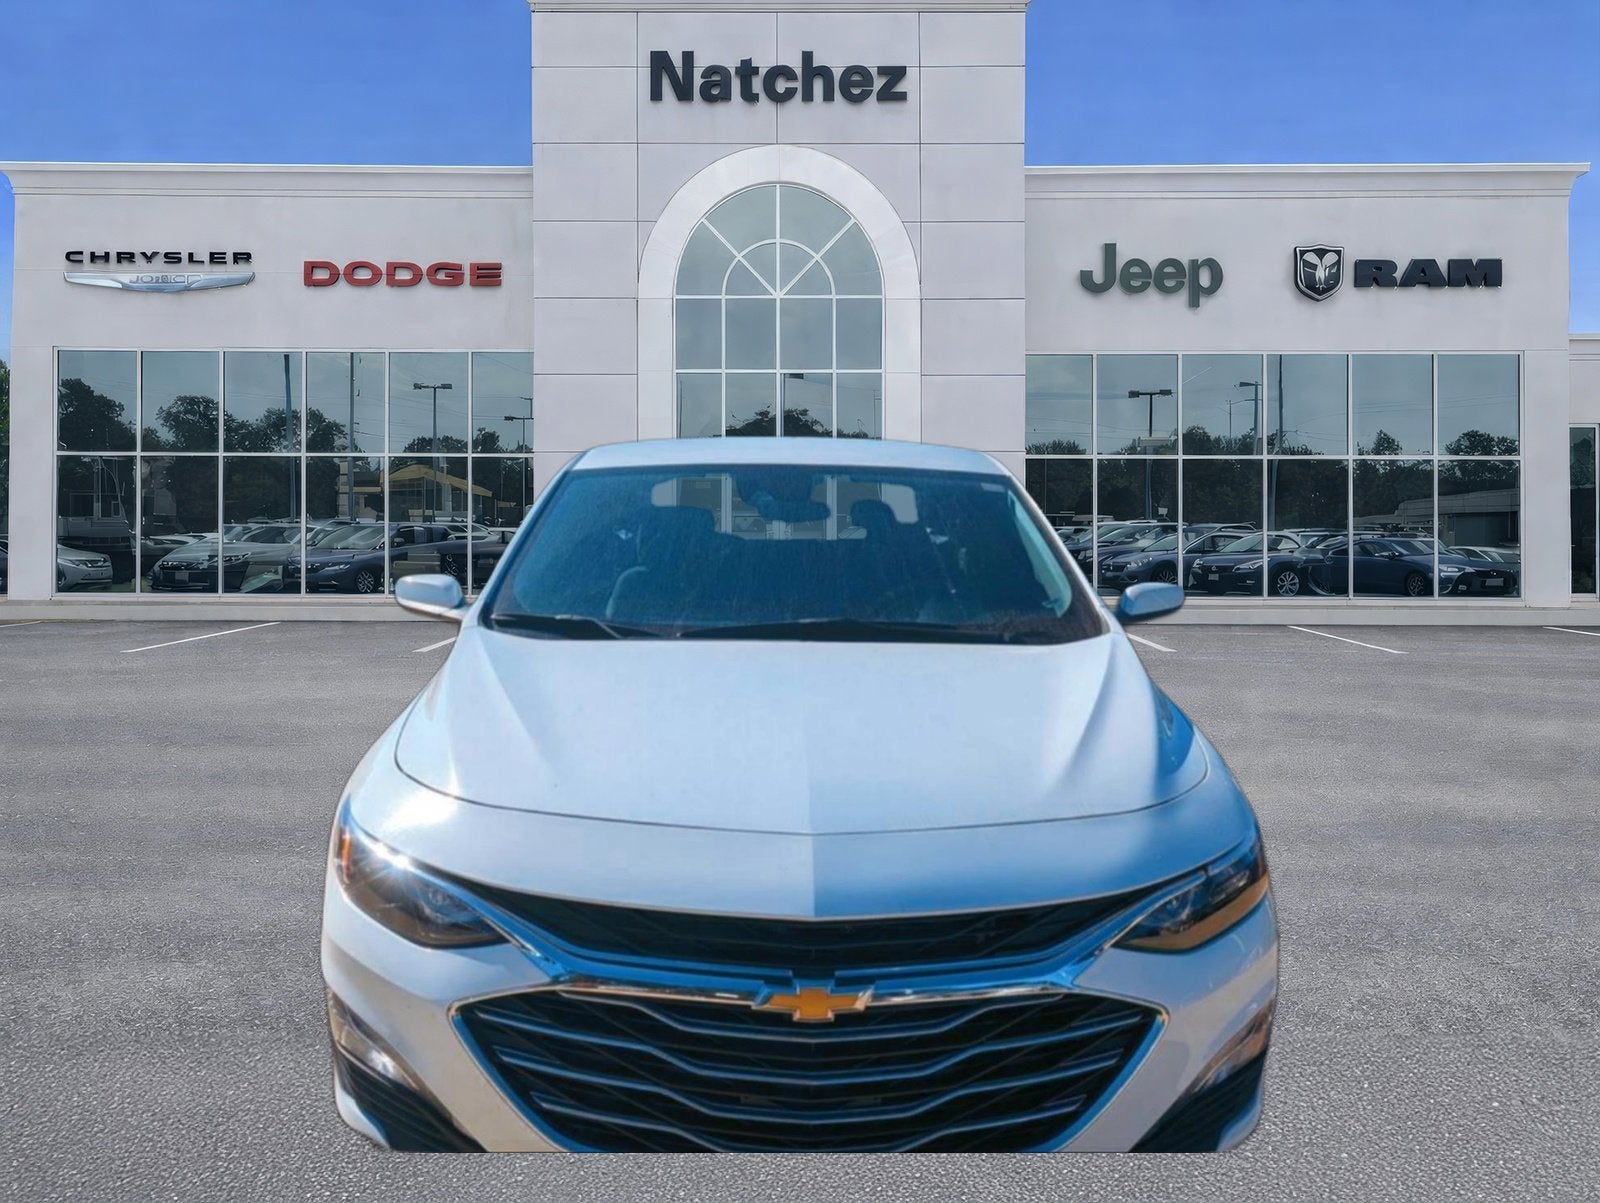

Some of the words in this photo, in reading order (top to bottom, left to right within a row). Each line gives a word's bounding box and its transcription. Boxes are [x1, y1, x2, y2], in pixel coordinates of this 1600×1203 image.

[650, 50, 907, 102] Natchez
[65, 250, 252, 264] CHRYSLER
[303, 260, 502, 287] DODGE
[1079, 242, 1223, 309] Jeep
[1354, 258, 1502, 288] RAM
